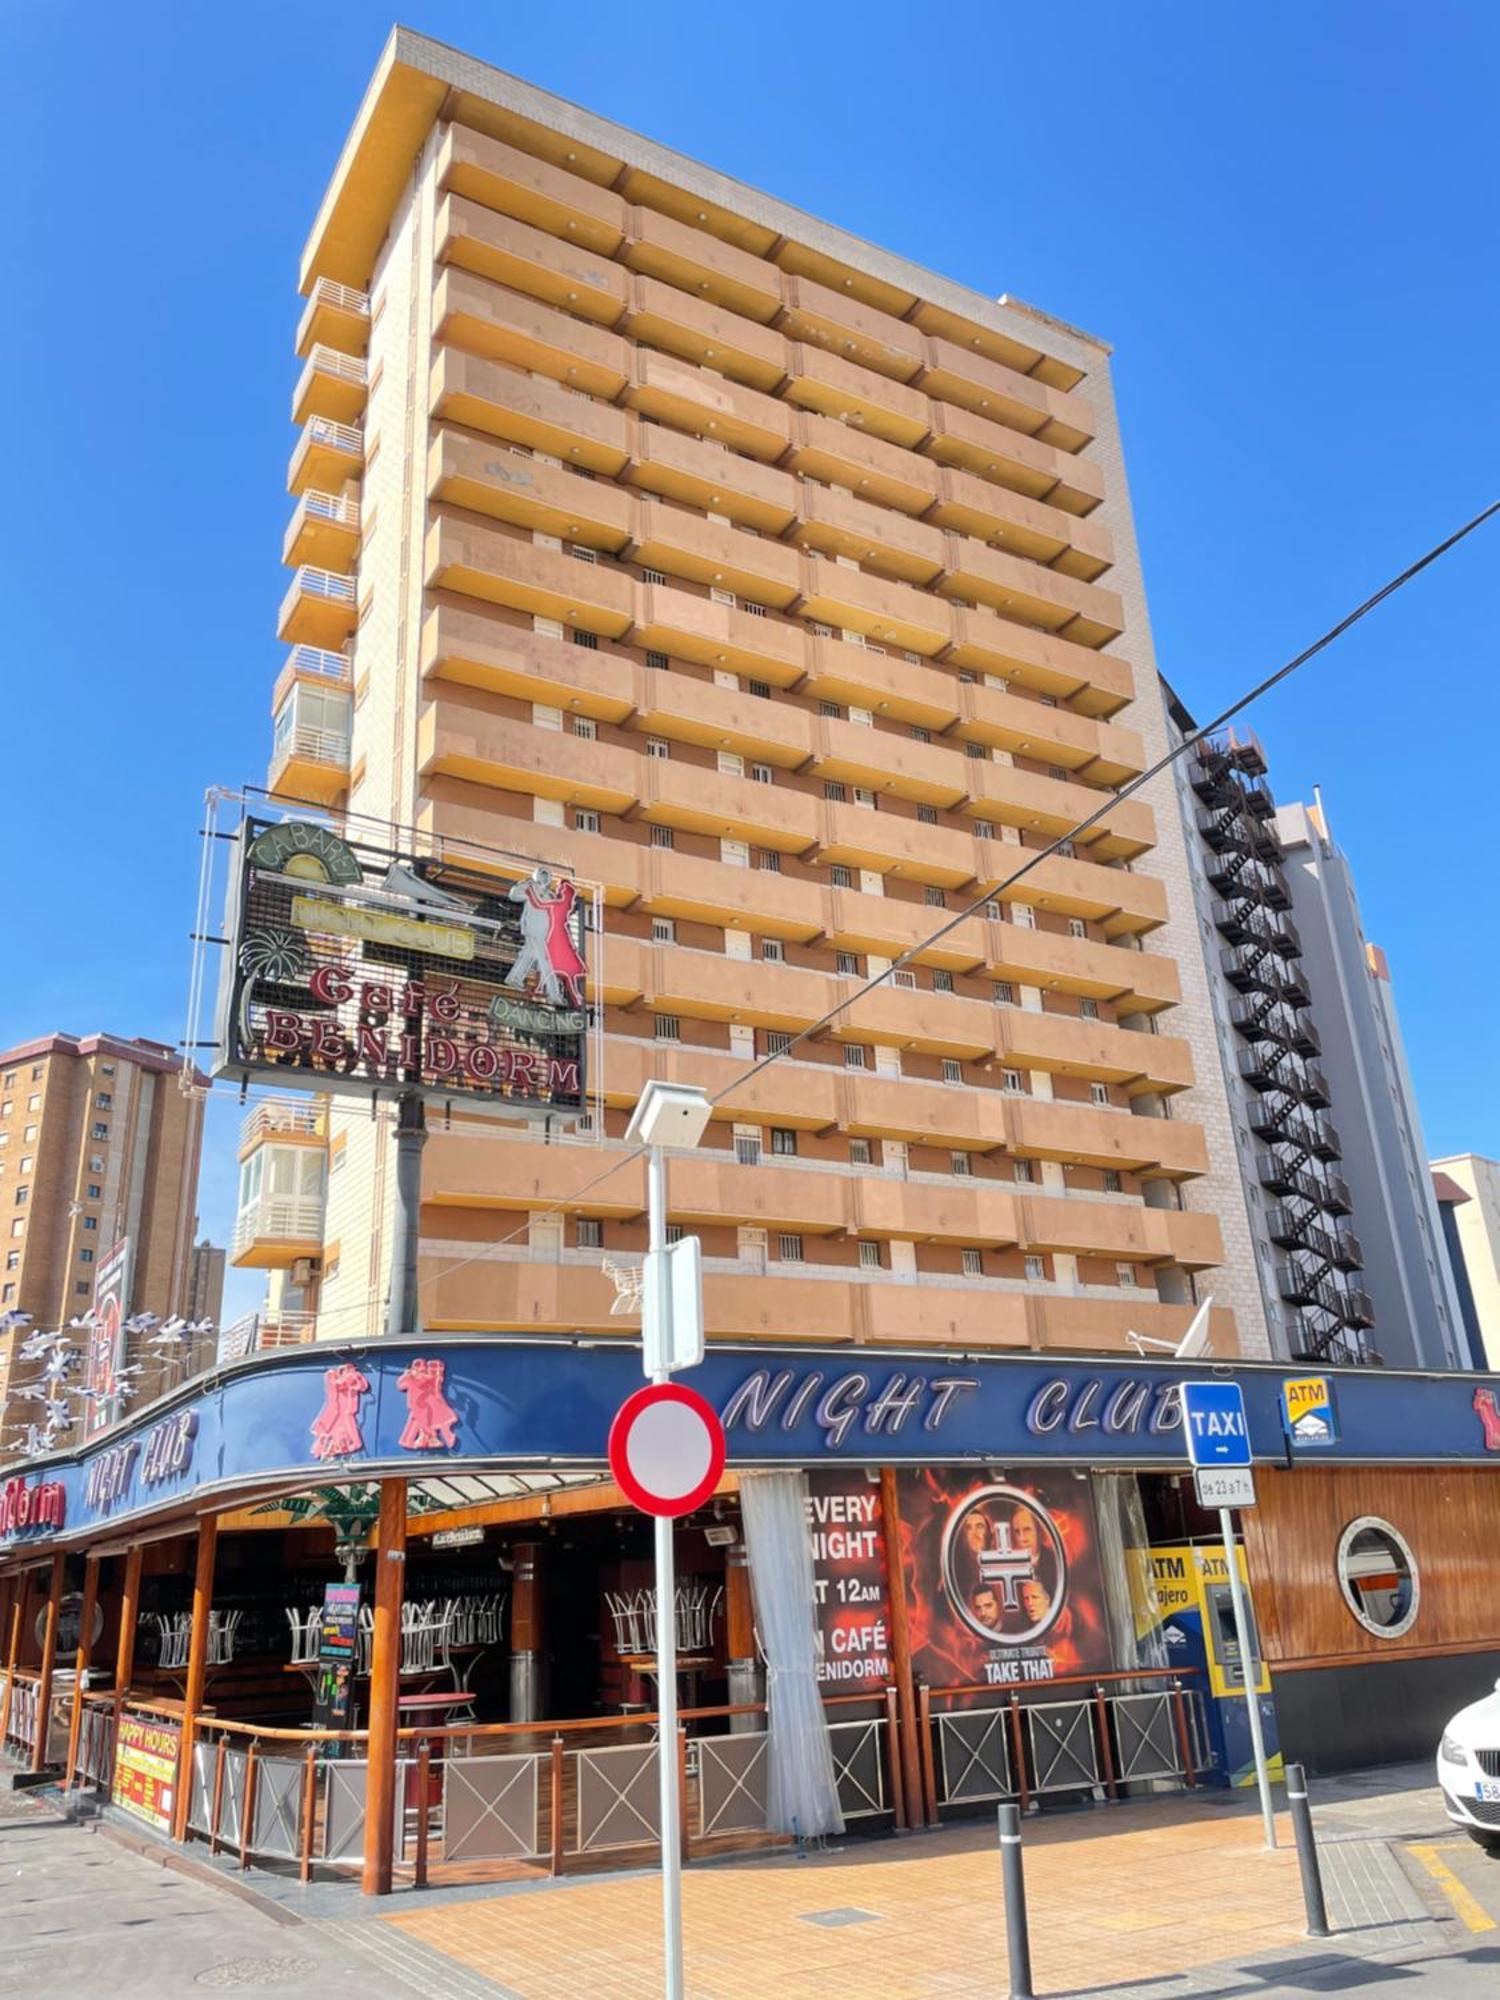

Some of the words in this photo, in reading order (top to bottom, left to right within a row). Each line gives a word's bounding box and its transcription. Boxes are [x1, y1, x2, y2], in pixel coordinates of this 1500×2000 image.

[255, 823, 361, 880] CABARET
[310, 966, 462, 1024] Café
[490, 997, 585, 1031] DANCING
[265, 1010, 580, 1092] BENIDORM
[1288, 1384, 1326, 1402] ATM
[720, 1369, 981, 1449] NIGHT
[1027, 1378, 1183, 1434] CLUB
[1191, 1411, 1245, 1437] TAXI
[141, 1408, 200, 1487] CLUB
[1215, 1479, 1227, 1496] 23
[801, 1495, 877, 1524] EVERY
[1157, 1585, 1189, 1607] ajero
[831, 1620, 888, 1654] CAFÉ
[816, 1657, 889, 1683] ENIDORM
[984, 1661, 1020, 1685] TAKE
[1021, 1658, 1056, 1682] THAT
[144, 1727, 178, 1758] HOURS
